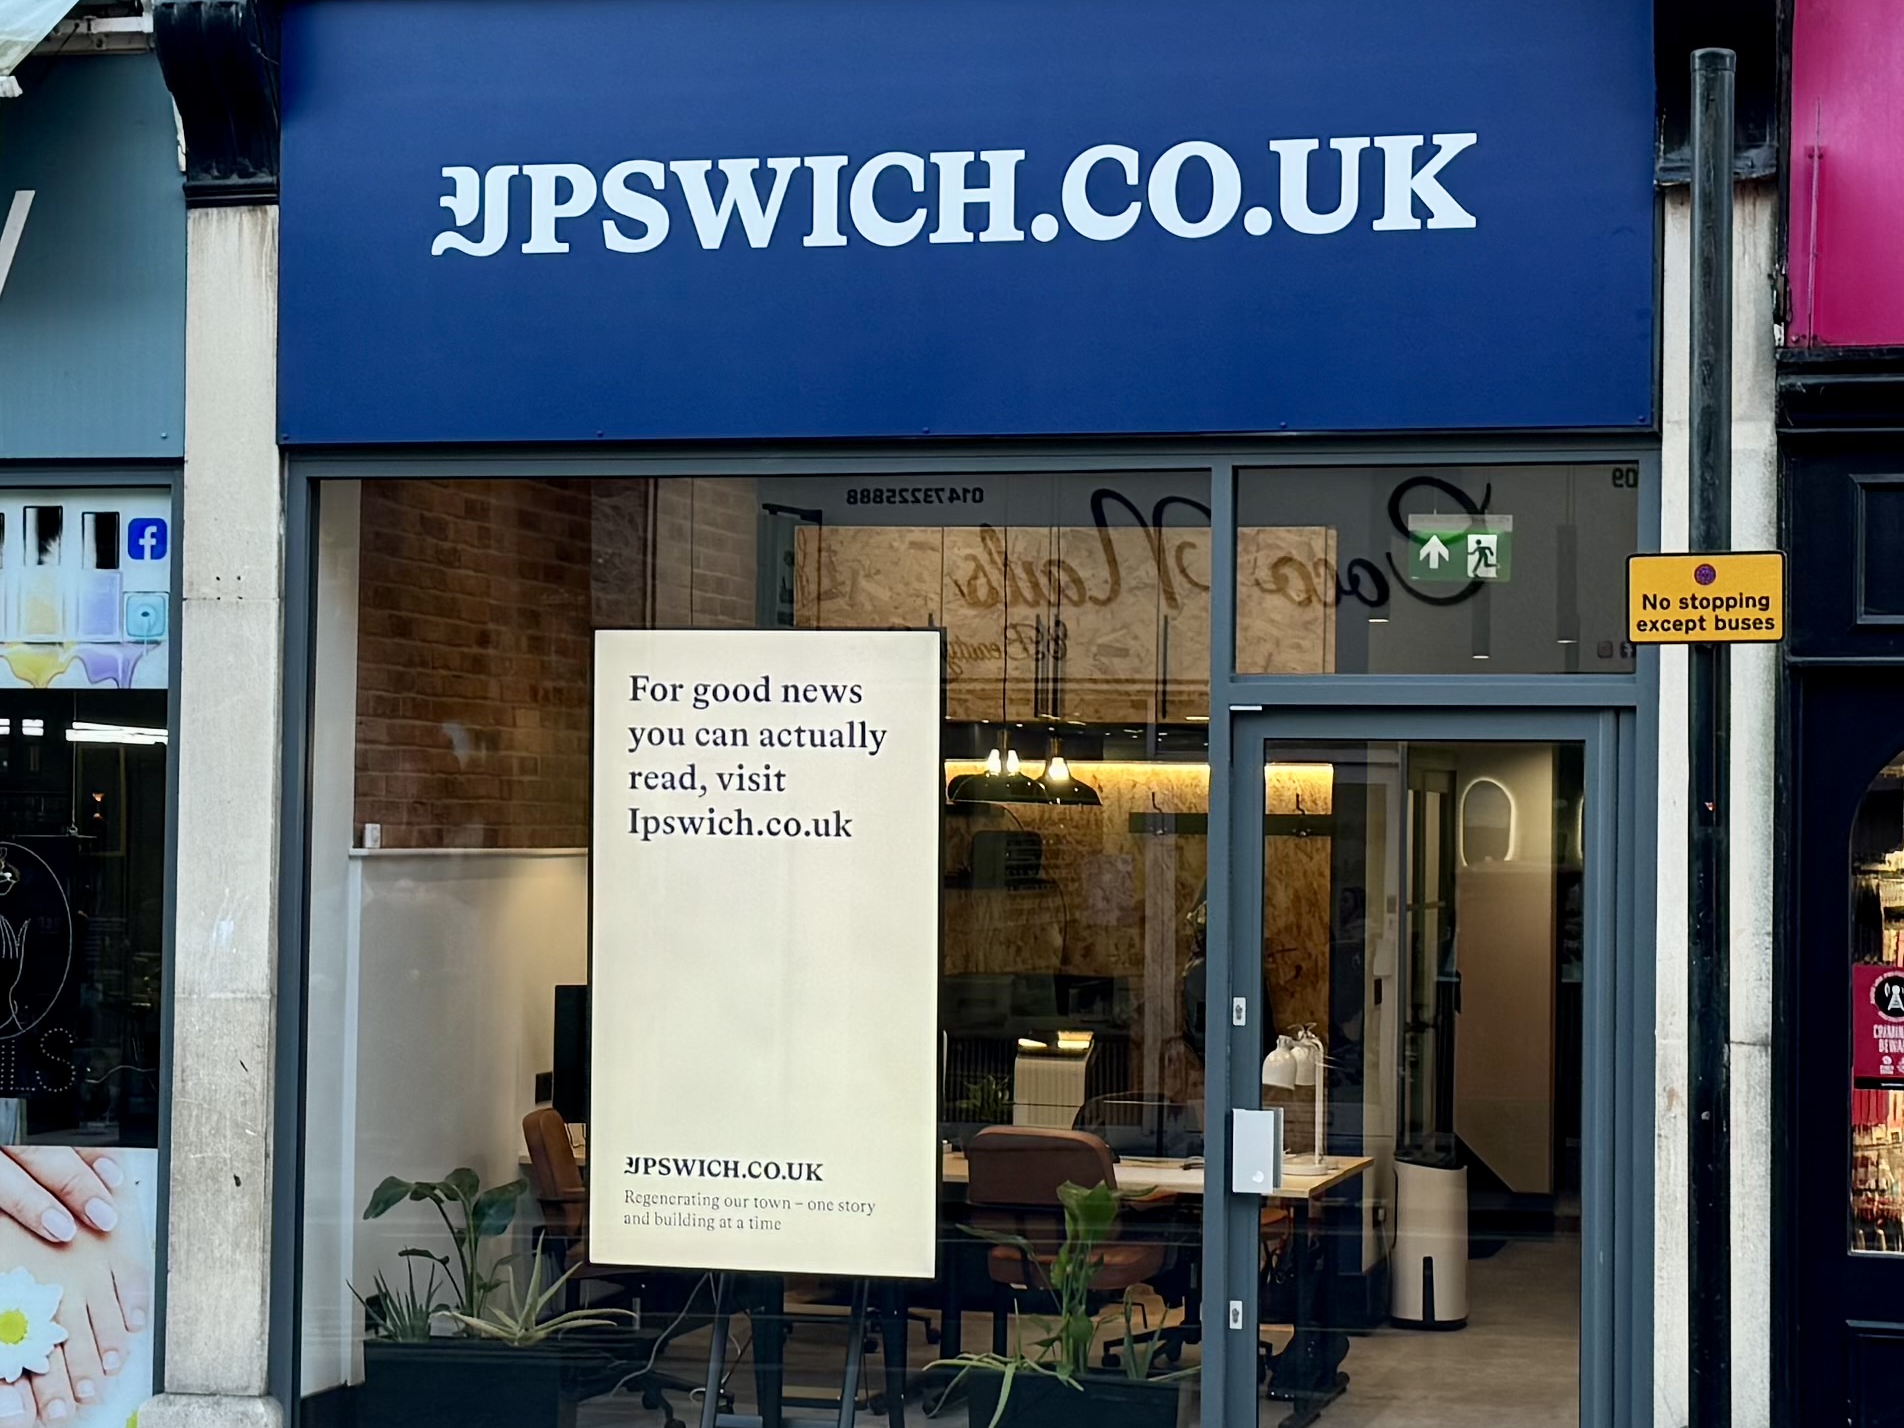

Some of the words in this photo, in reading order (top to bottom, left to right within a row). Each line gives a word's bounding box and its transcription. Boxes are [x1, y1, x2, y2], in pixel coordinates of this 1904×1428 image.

[1641, 593, 1671, 611] No
[1678, 592, 1771, 616] stopping
[1636, 616, 1707, 635] except
[1714, 613, 1776, 632] buses
[628, 675, 684, 703] For
[692, 675, 772, 710] good
[781, 682, 863, 704] news
[627, 726, 686, 753] you
[695, 725, 749, 747] can
[759, 720, 888, 756] actually
[628, 763, 707, 797] read,
[716, 764, 786, 792] visit
[628, 807, 853, 842] Ipswich.co.uk
[624, 1189, 720, 1211] Regenerating
[723, 1197, 750, 1210] our
[753, 1197, 791, 1210] town
[807, 1199, 834, 1212] one
[837, 1200, 876, 1217] story
[624, 1211, 650, 1226] and
[654, 1212, 715, 1231] building
[719, 1216, 733, 1229] at
[736, 1218, 744, 1230] a
[749, 1215, 782, 1231] time
